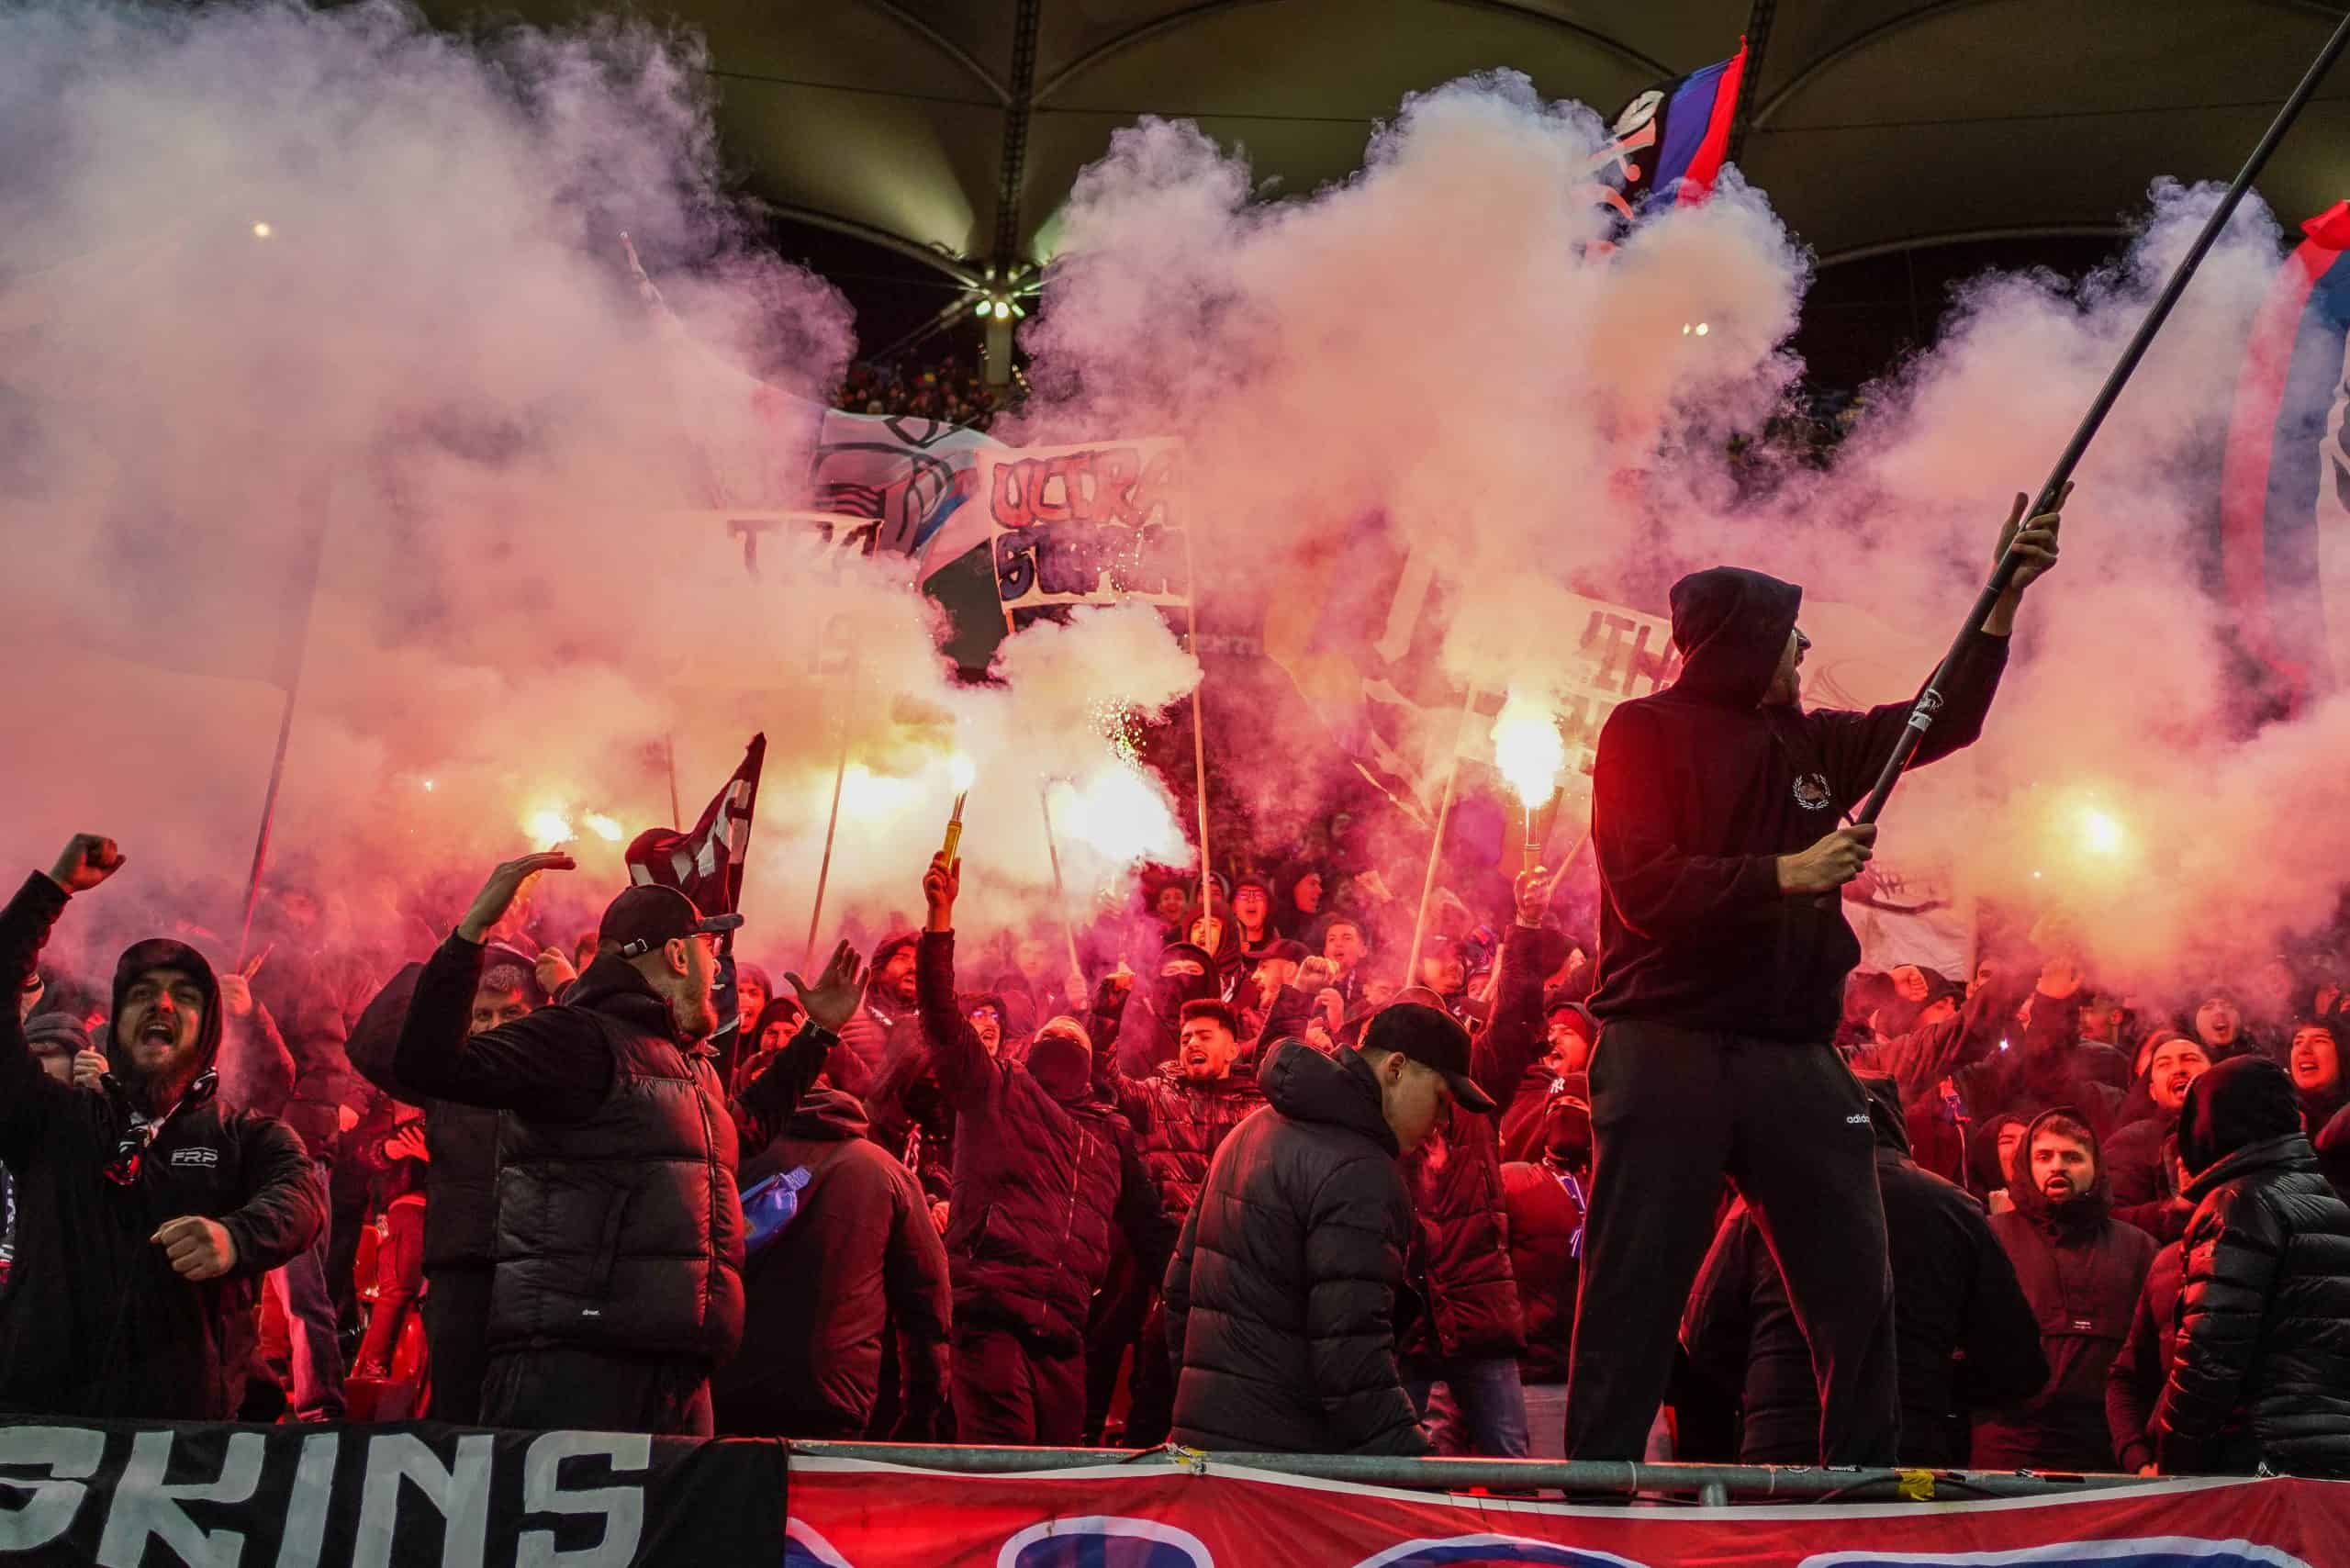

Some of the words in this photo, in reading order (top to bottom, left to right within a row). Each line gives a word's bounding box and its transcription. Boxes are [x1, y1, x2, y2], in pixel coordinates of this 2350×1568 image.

[1846, 1114, 1871, 1124] adid
[171, 1150, 218, 1163] FRP
[0, 1427, 652, 1568] SKINS
